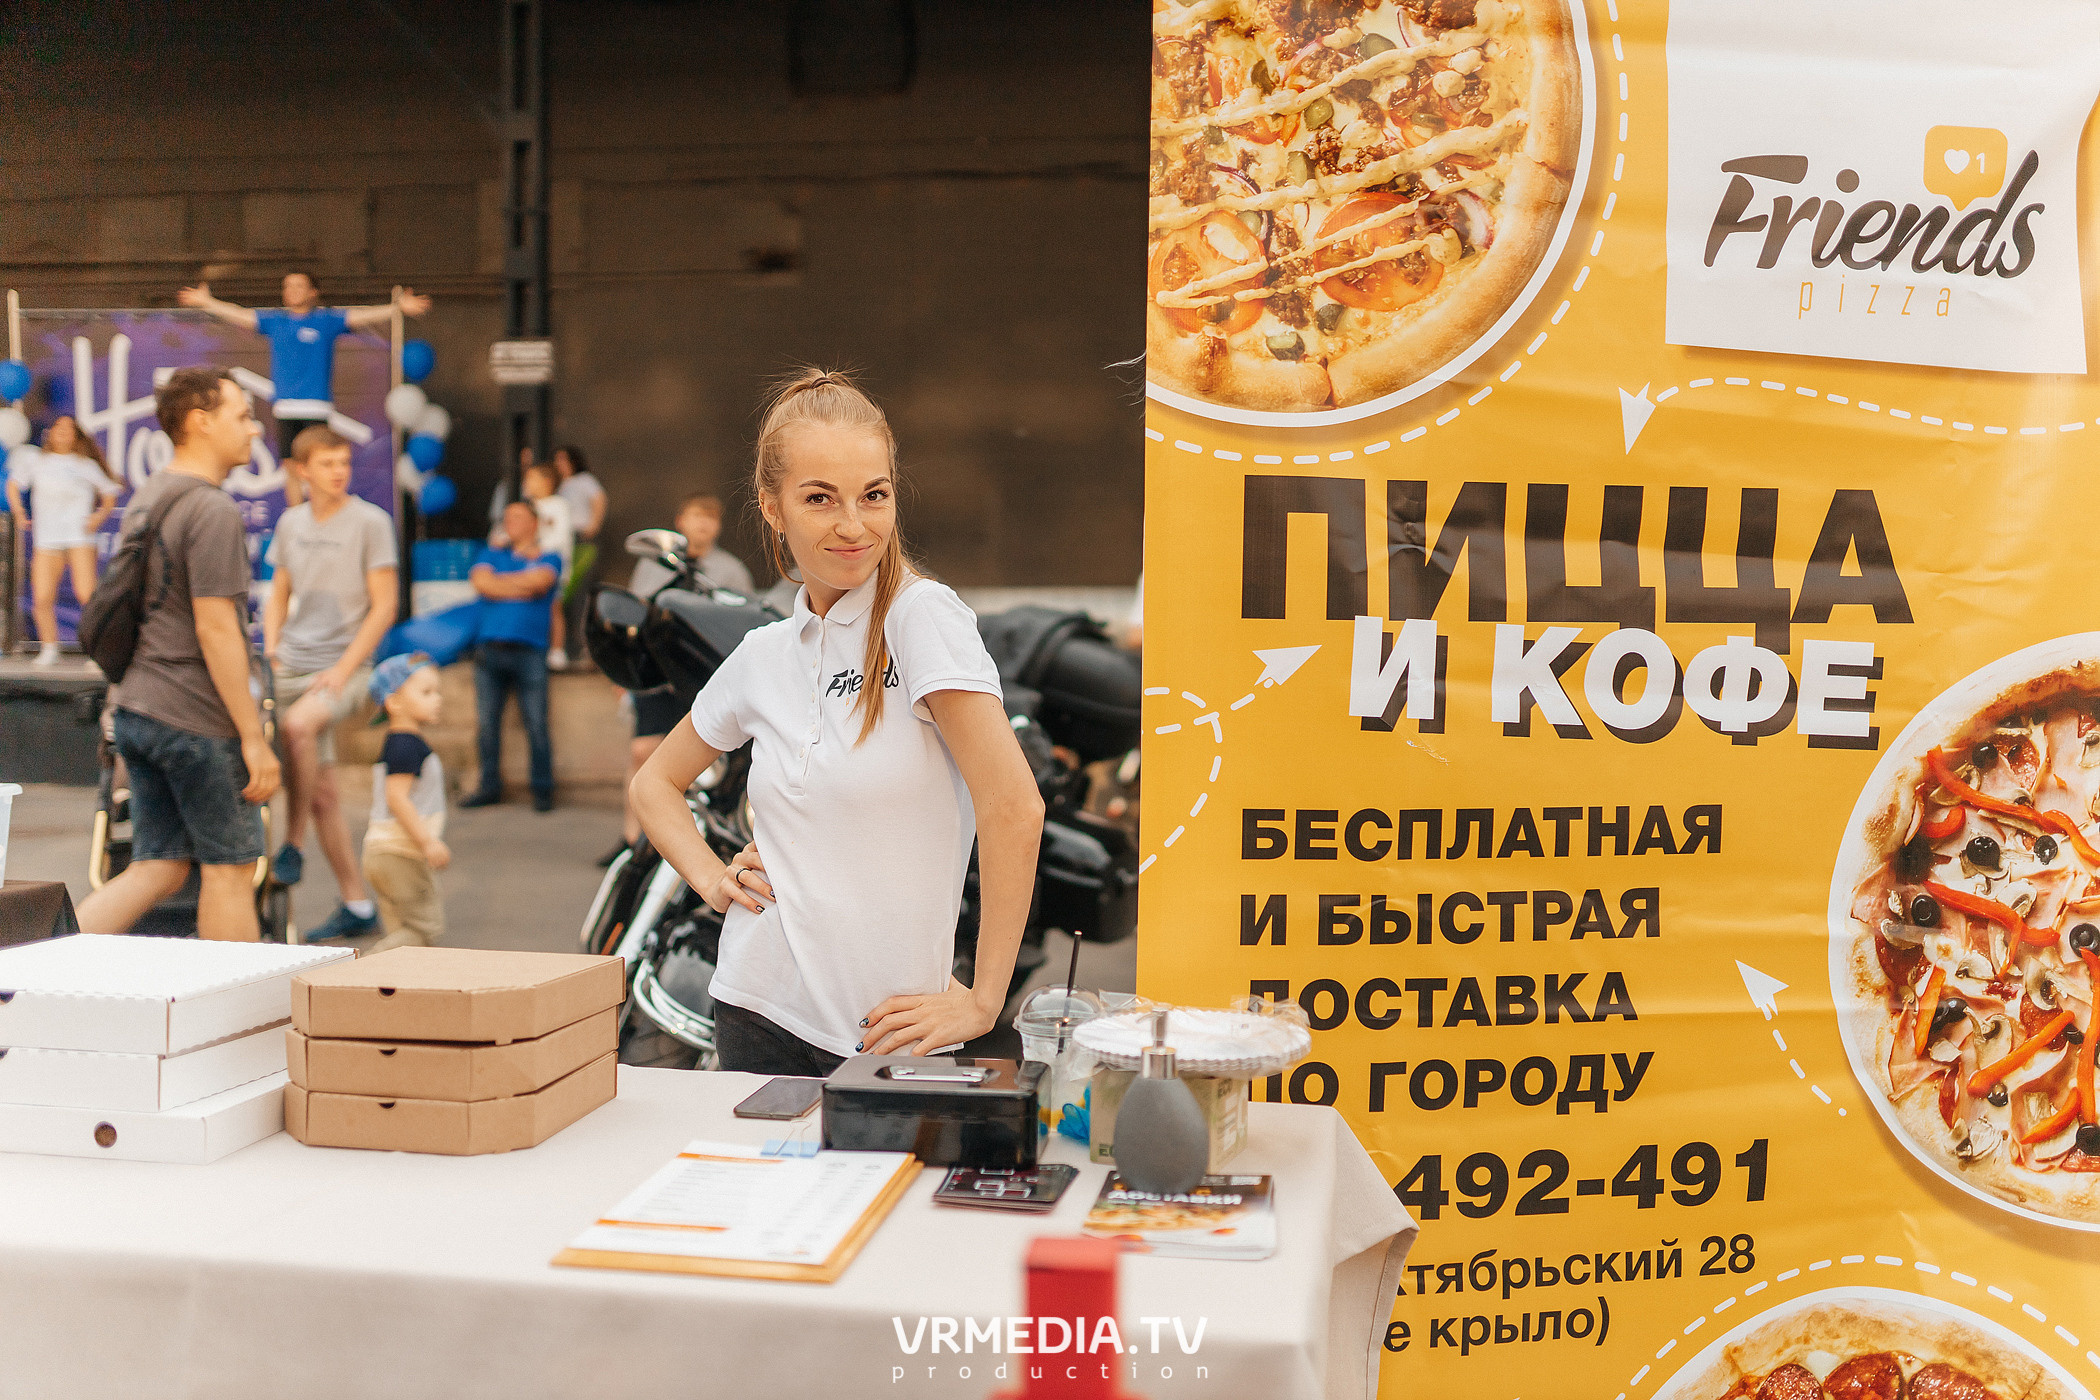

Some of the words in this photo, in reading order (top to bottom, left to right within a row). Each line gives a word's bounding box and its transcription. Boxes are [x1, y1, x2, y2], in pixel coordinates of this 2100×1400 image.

[1975, 152, 1986, 174] 1
[1704, 150, 2046, 279] Friends
[1799, 275, 1951, 319] pizza
[1241, 475, 1914, 655] ПИЦЦА
[825, 654, 899, 698] Frieds
[1349, 615, 1440, 722] И
[1491, 623, 1876, 740] КОФЕ
[1241, 804, 1723, 861] БЕСПЛАТНАЯ
[1239, 894, 1288, 946] И
[1317, 886, 1661, 946] БЫСТРАЯ
[1368, 1051, 1656, 1116] ГОРОДУ
[1393, 1138, 1769, 1221] 492-491
[1699, 1233, 1757, 1277] 28
[1429, 1297, 1611, 1357] крыло)
